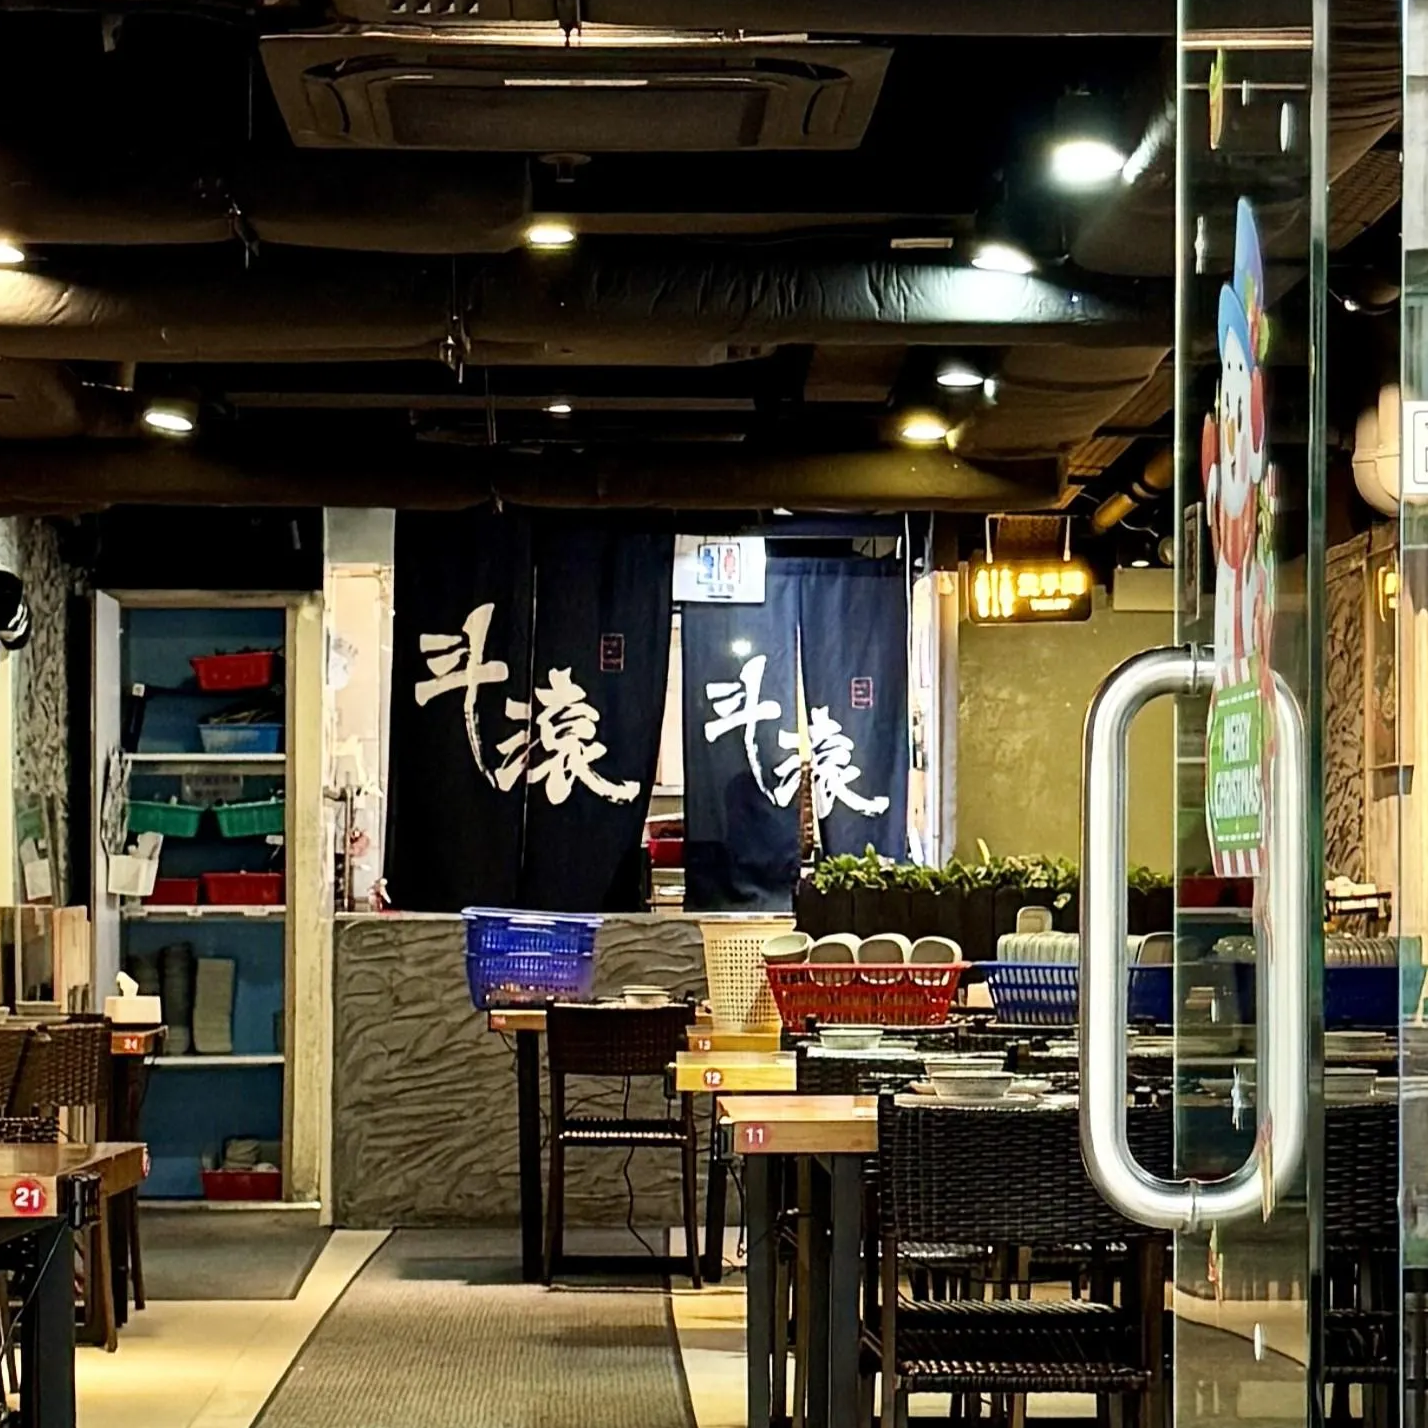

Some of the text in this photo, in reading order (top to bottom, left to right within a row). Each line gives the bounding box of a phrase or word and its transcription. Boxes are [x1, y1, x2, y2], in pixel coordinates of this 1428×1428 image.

[705, 1071, 721, 1085] 12
[745, 1127, 764, 1144] 11
[14, 1186, 41, 1209] 21
